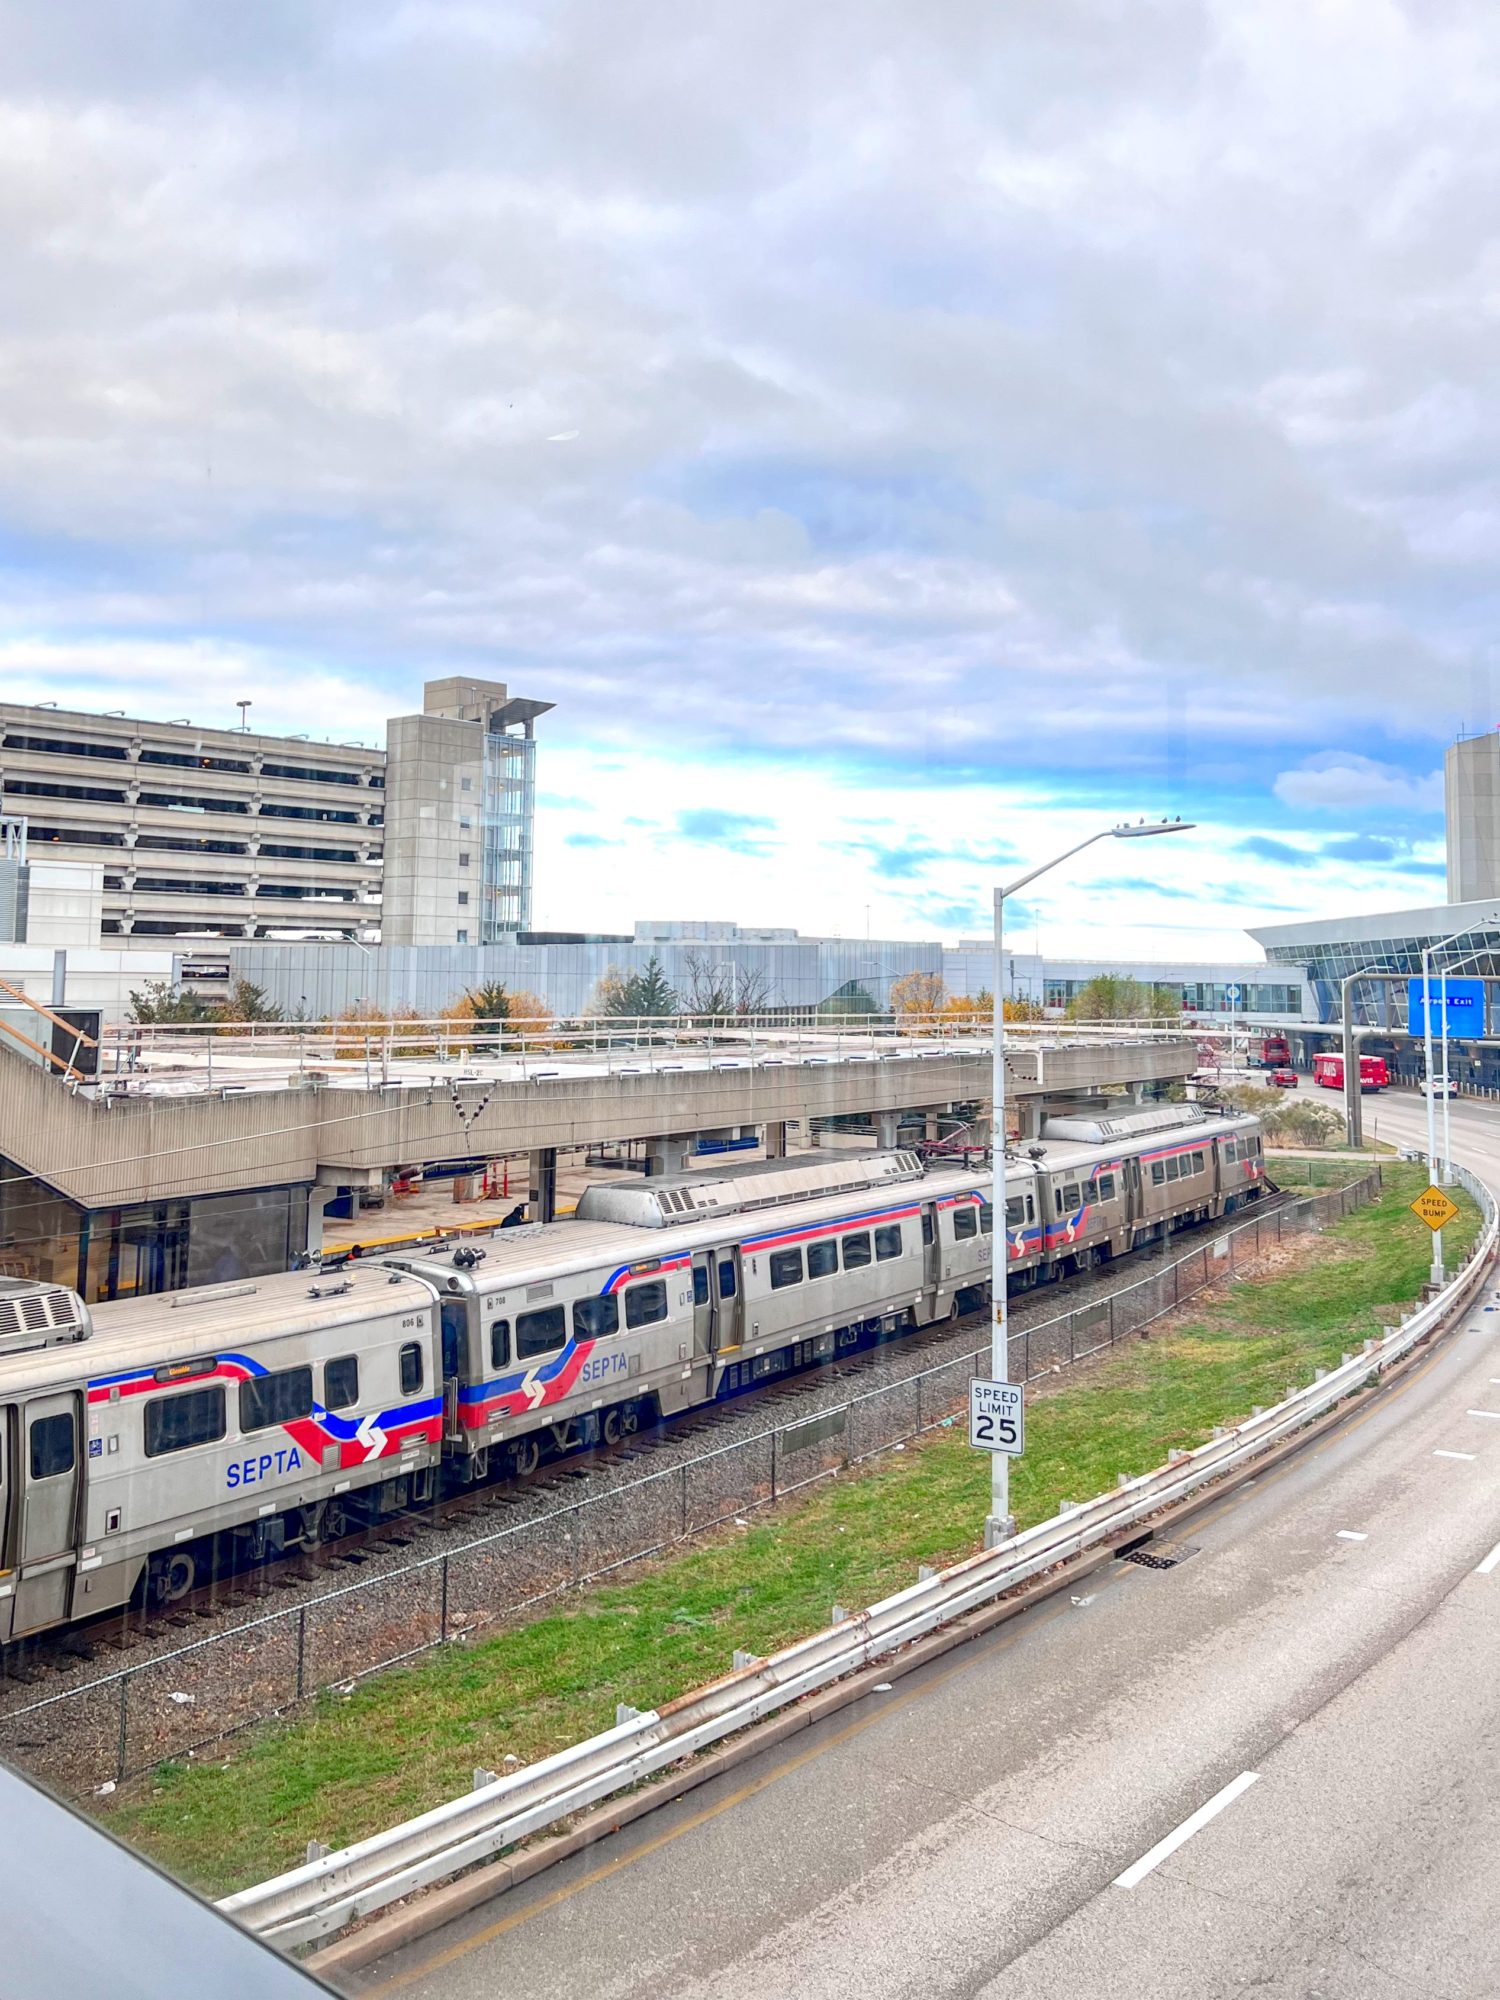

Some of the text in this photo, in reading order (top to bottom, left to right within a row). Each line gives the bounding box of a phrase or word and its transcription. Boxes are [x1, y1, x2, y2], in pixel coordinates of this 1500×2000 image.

[1323, 1062, 1336, 1077] AVIS
[1421, 1198, 1447, 1207] SPEED
[1423, 1209, 1446, 1217] BUMP
[978, 1247, 991, 1262] SEP
[582, 1352, 627, 1382] SEPTA
[975, 1387, 1018, 1403] SPEED
[979, 1401, 1013, 1416] LIMIT
[976, 1415, 1017, 1444] 25
[226, 1447, 301, 1488] SEPTA
